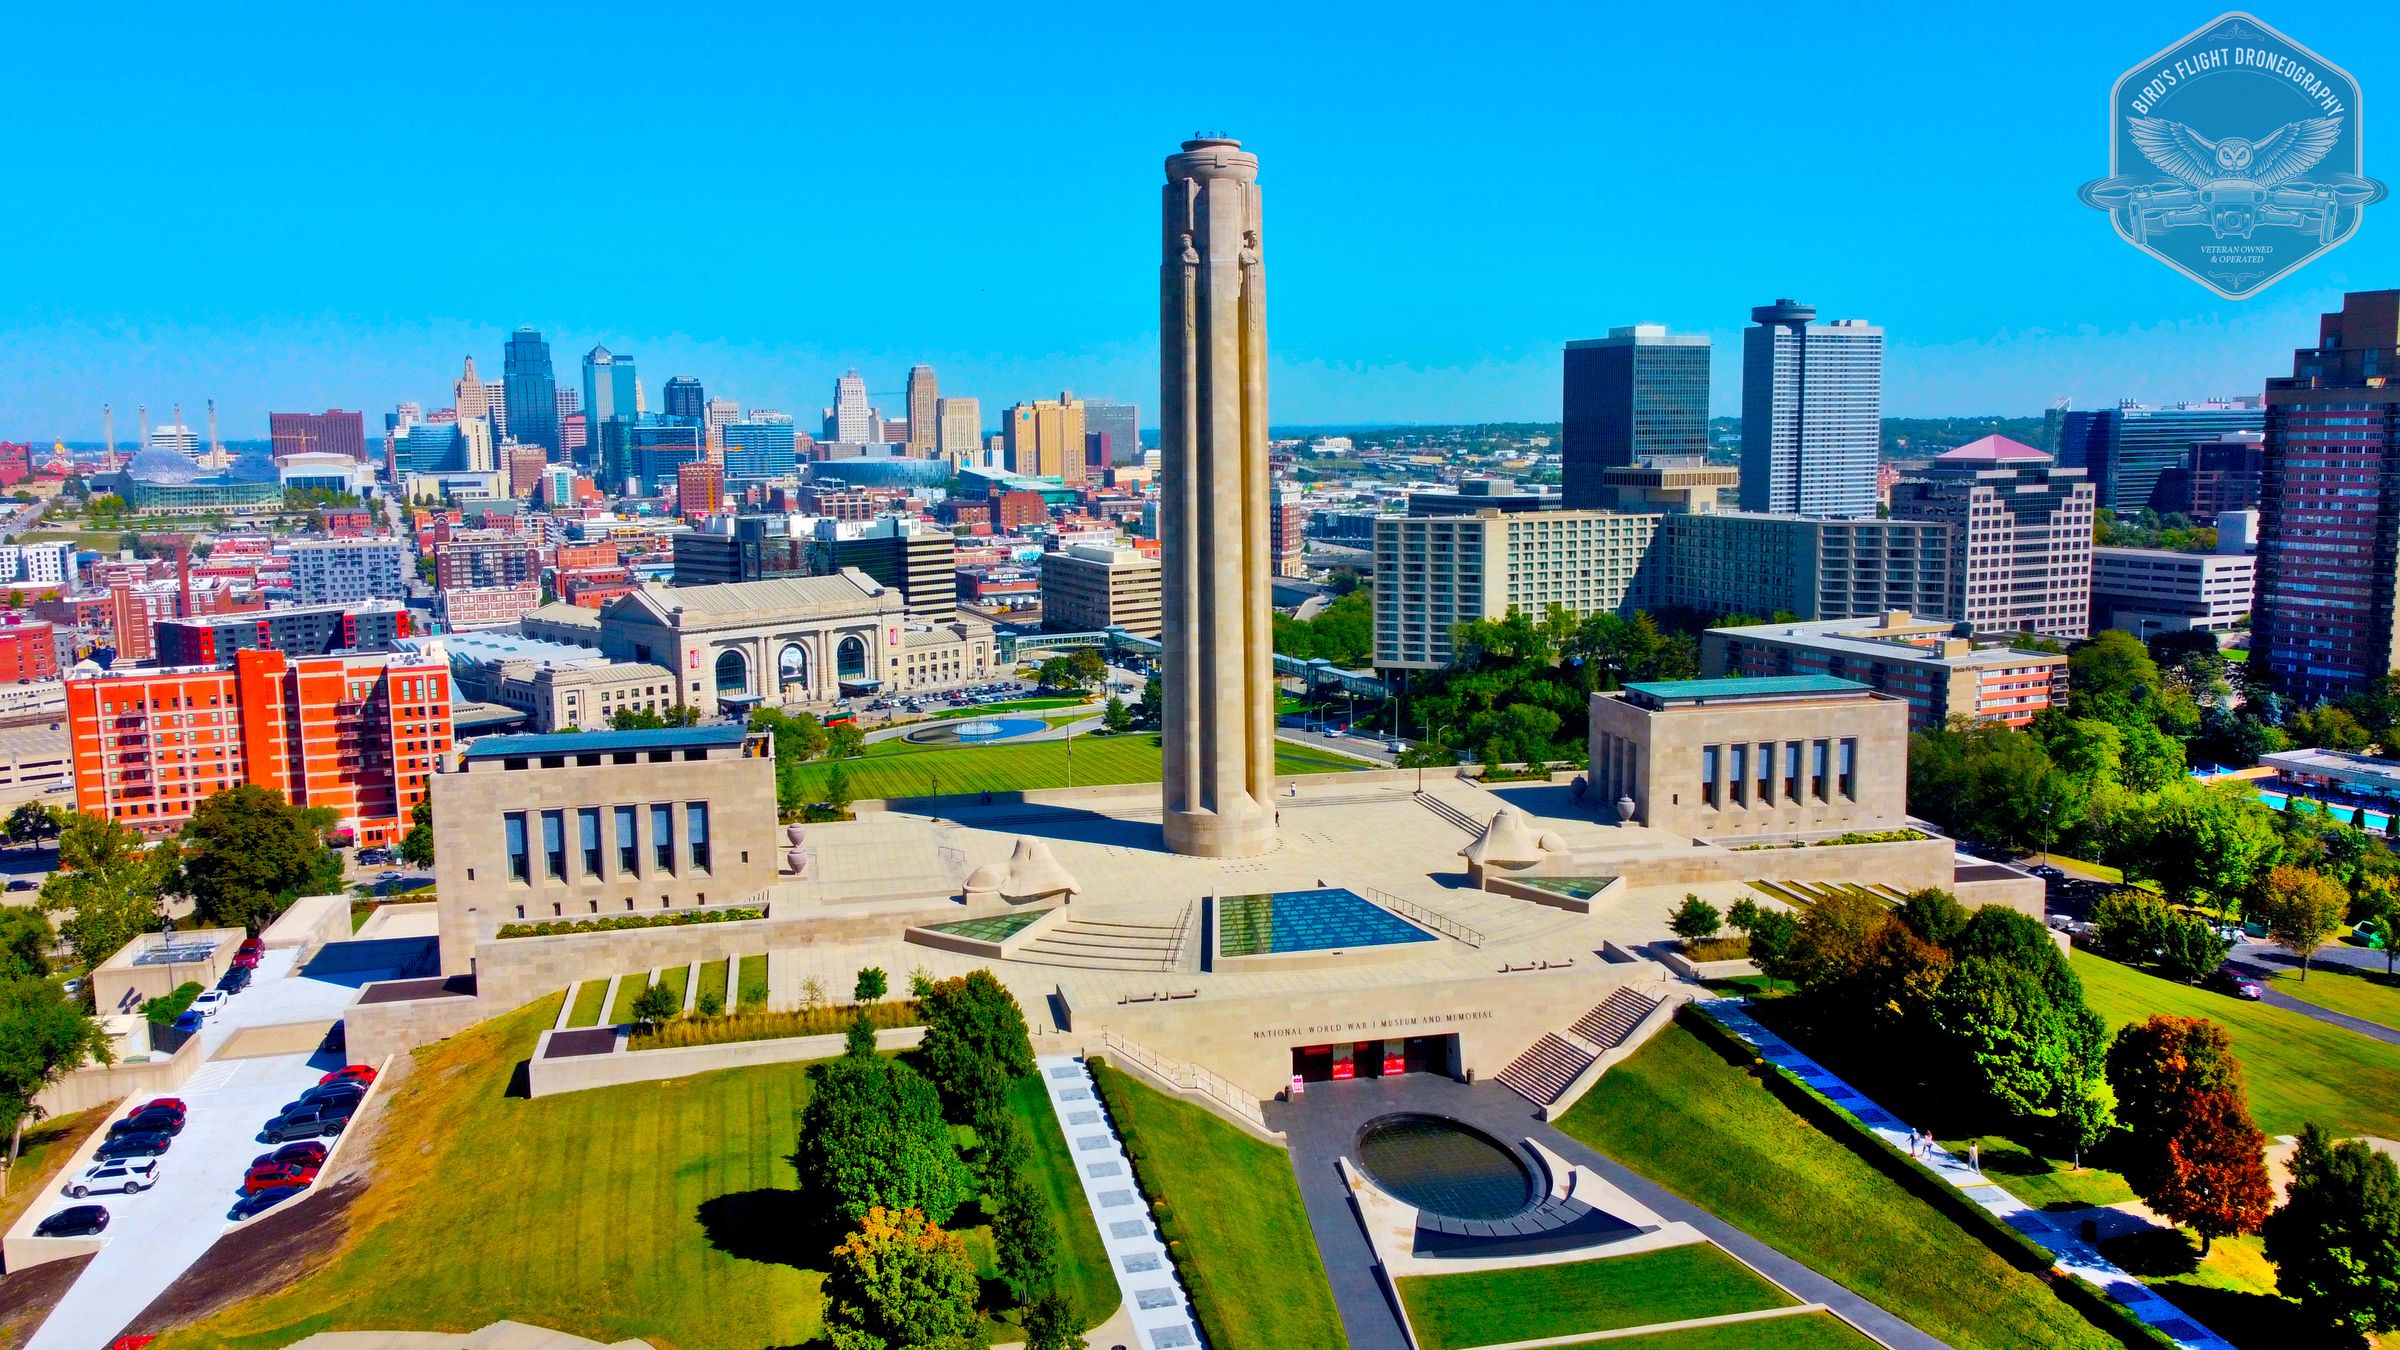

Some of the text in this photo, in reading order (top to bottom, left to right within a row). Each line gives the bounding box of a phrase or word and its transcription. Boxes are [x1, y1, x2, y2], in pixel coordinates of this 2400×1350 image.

[1253, 1027, 1303, 1039] NATIONAL
[1308, 1023, 1342, 1033] WORLD
[1347, 1022, 1368, 1030] WAR
[1381, 1017, 1418, 1027] MUSEUM
[1422, 1015, 1441, 1023] AND
[1446, 1010, 1494, 1022] MEMORIAL
